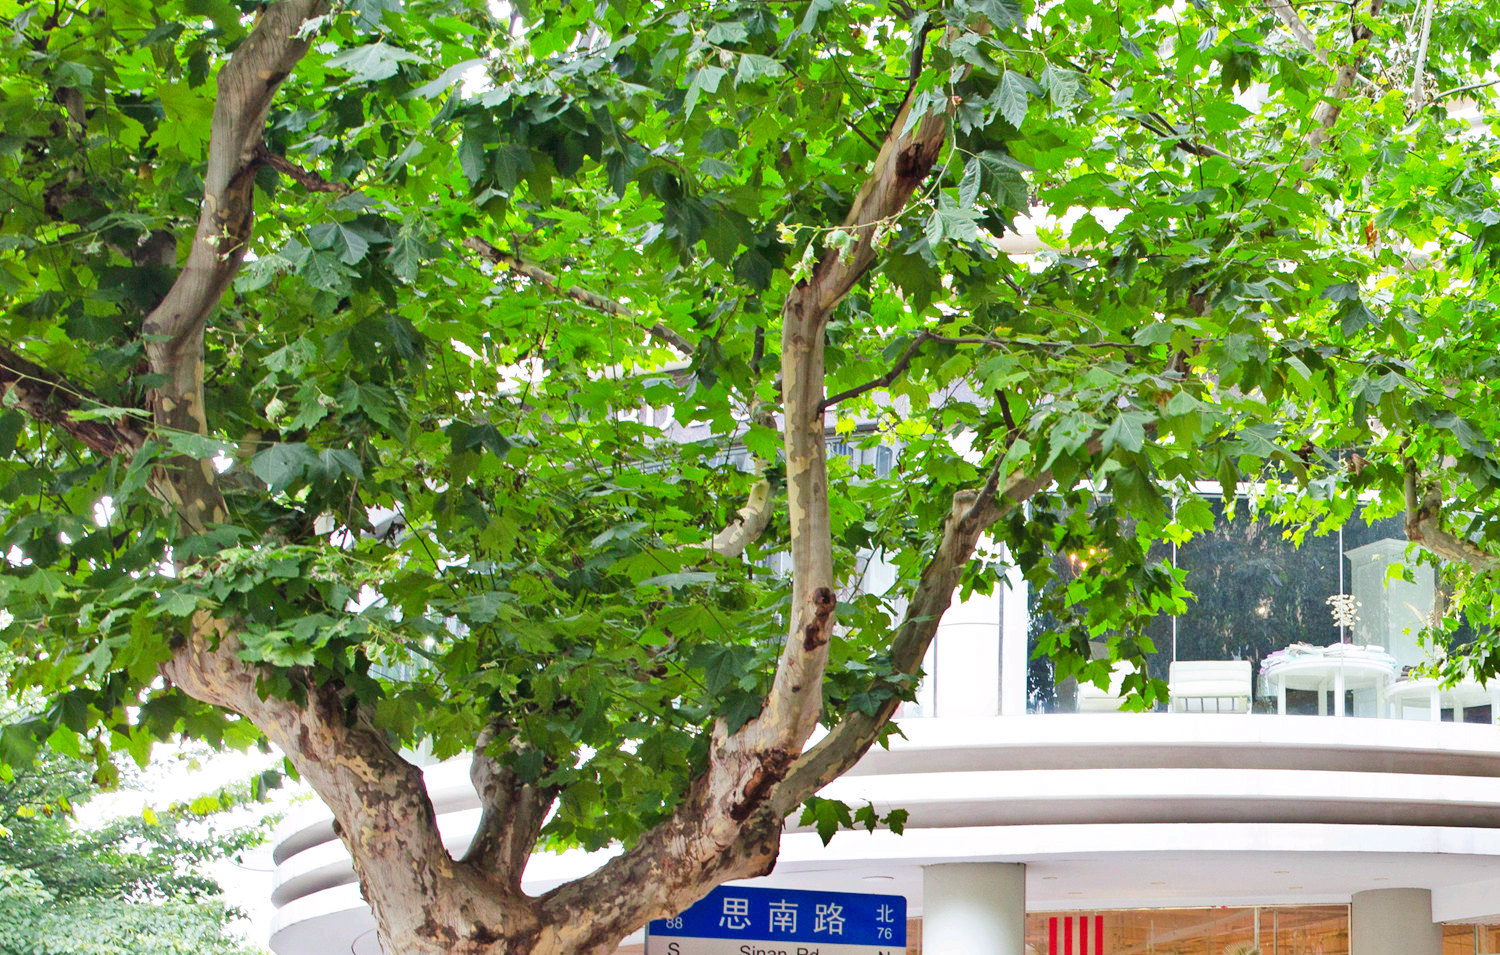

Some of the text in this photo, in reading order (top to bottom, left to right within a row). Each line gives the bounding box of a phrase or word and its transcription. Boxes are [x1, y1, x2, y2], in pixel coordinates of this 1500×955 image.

[718, 897, 846, 935] 思南路
[875, 904, 894, 923] 北
[665, 916, 683, 930] 88
[875, 927, 893, 940] 76
